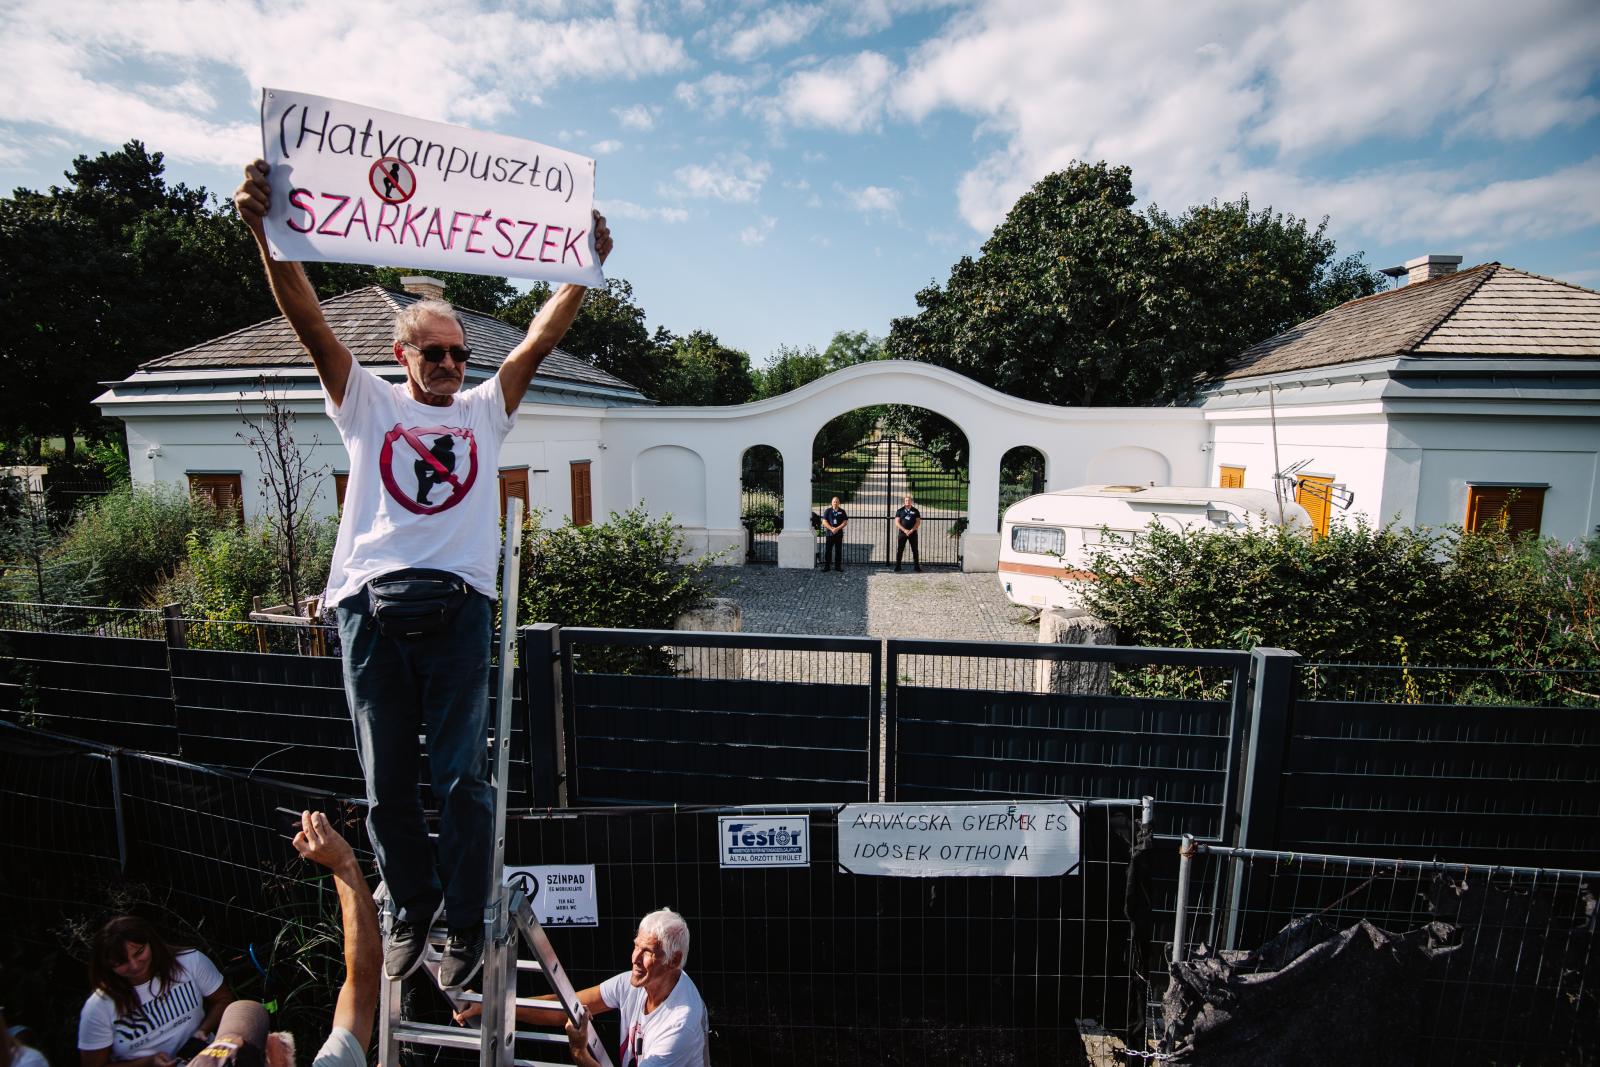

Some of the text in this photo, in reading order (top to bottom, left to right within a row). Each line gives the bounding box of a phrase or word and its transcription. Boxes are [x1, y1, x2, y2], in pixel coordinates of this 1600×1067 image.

[279, 103, 574, 203] (Hatvanpuszta)
[286, 187, 587, 267] SZARKAFÉSZEK
[851, 812, 952, 831] ÁRVÁCSKA
[729, 853, 748, 862] ÁLTAL
[775, 853, 802, 861] TERÜLET
[940, 844, 1029, 862] OTTHONA
[546, 873, 585, 885] SZÍNPAD
